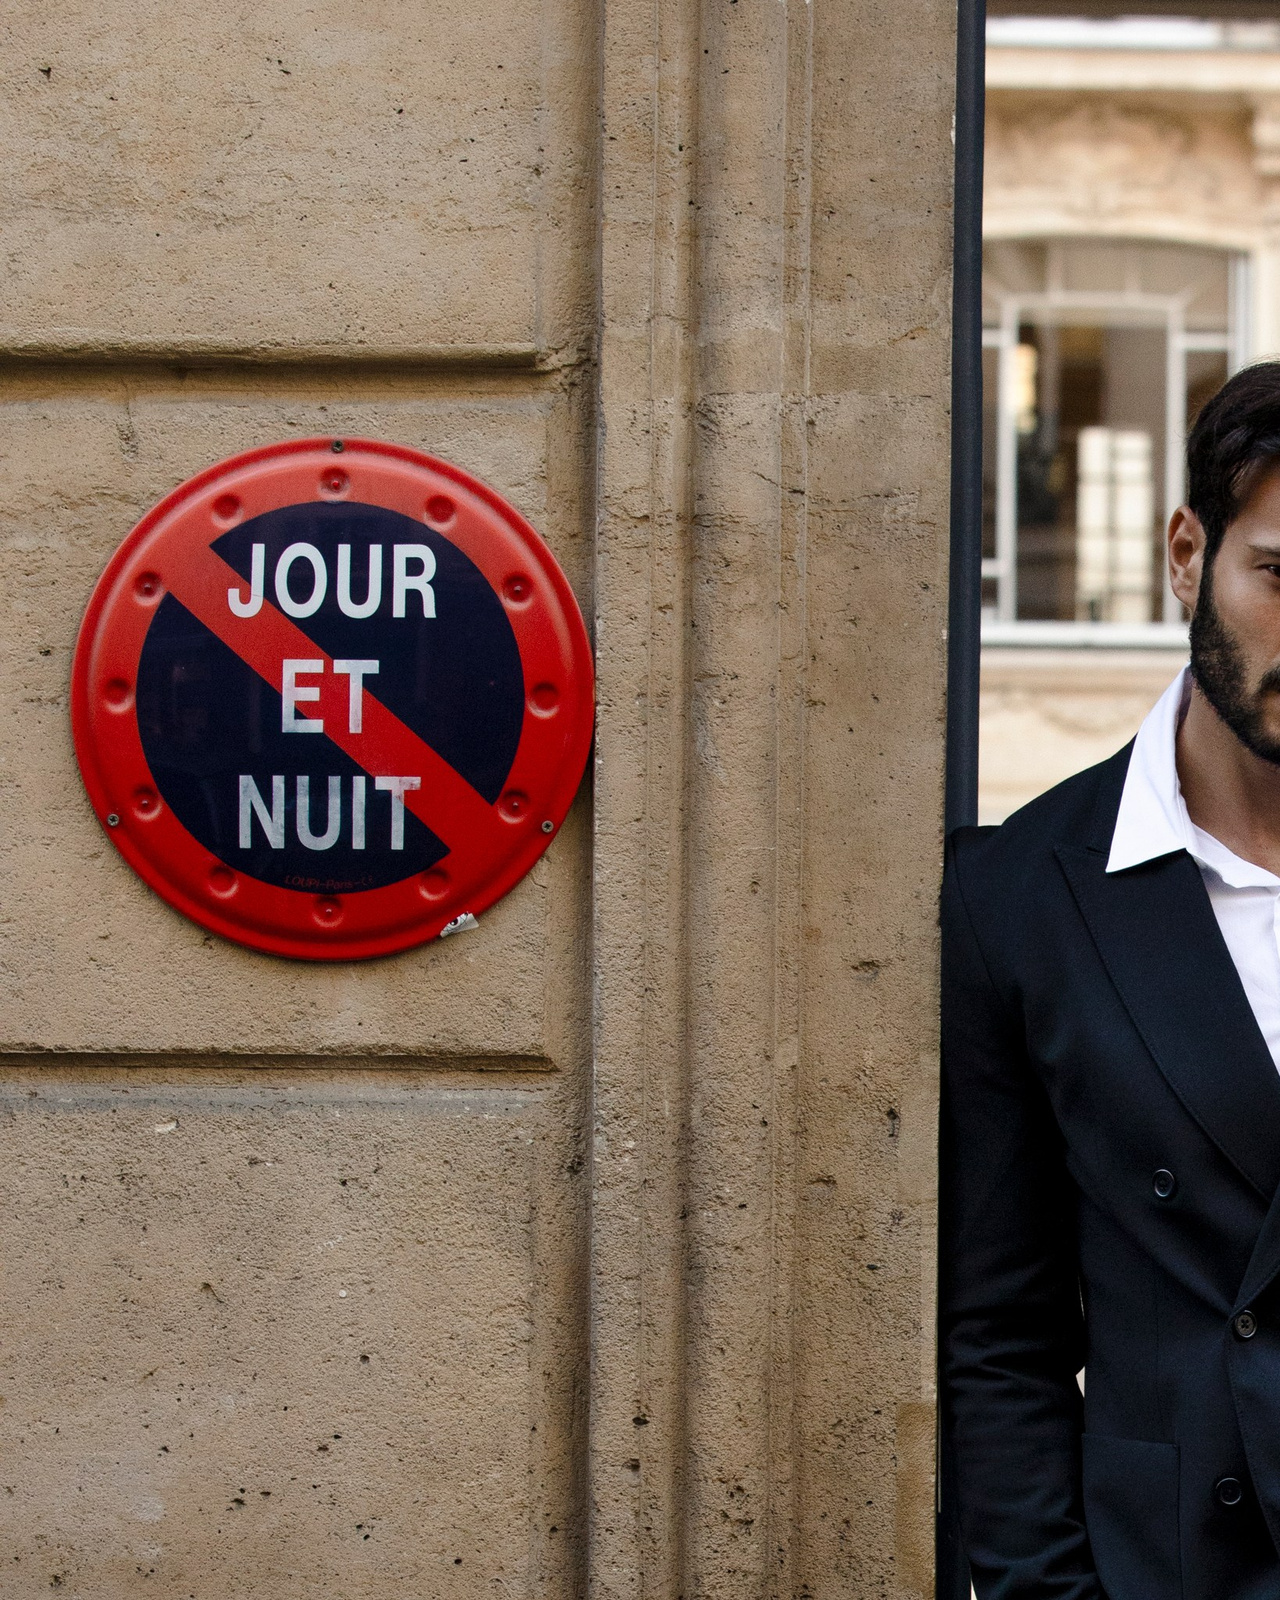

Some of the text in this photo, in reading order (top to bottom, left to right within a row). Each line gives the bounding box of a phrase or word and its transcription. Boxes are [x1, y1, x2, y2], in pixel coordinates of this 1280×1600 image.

[227, 542, 437, 619] JOUR
[281, 659, 380, 734] ET
[238, 774, 421, 851] NUIT
